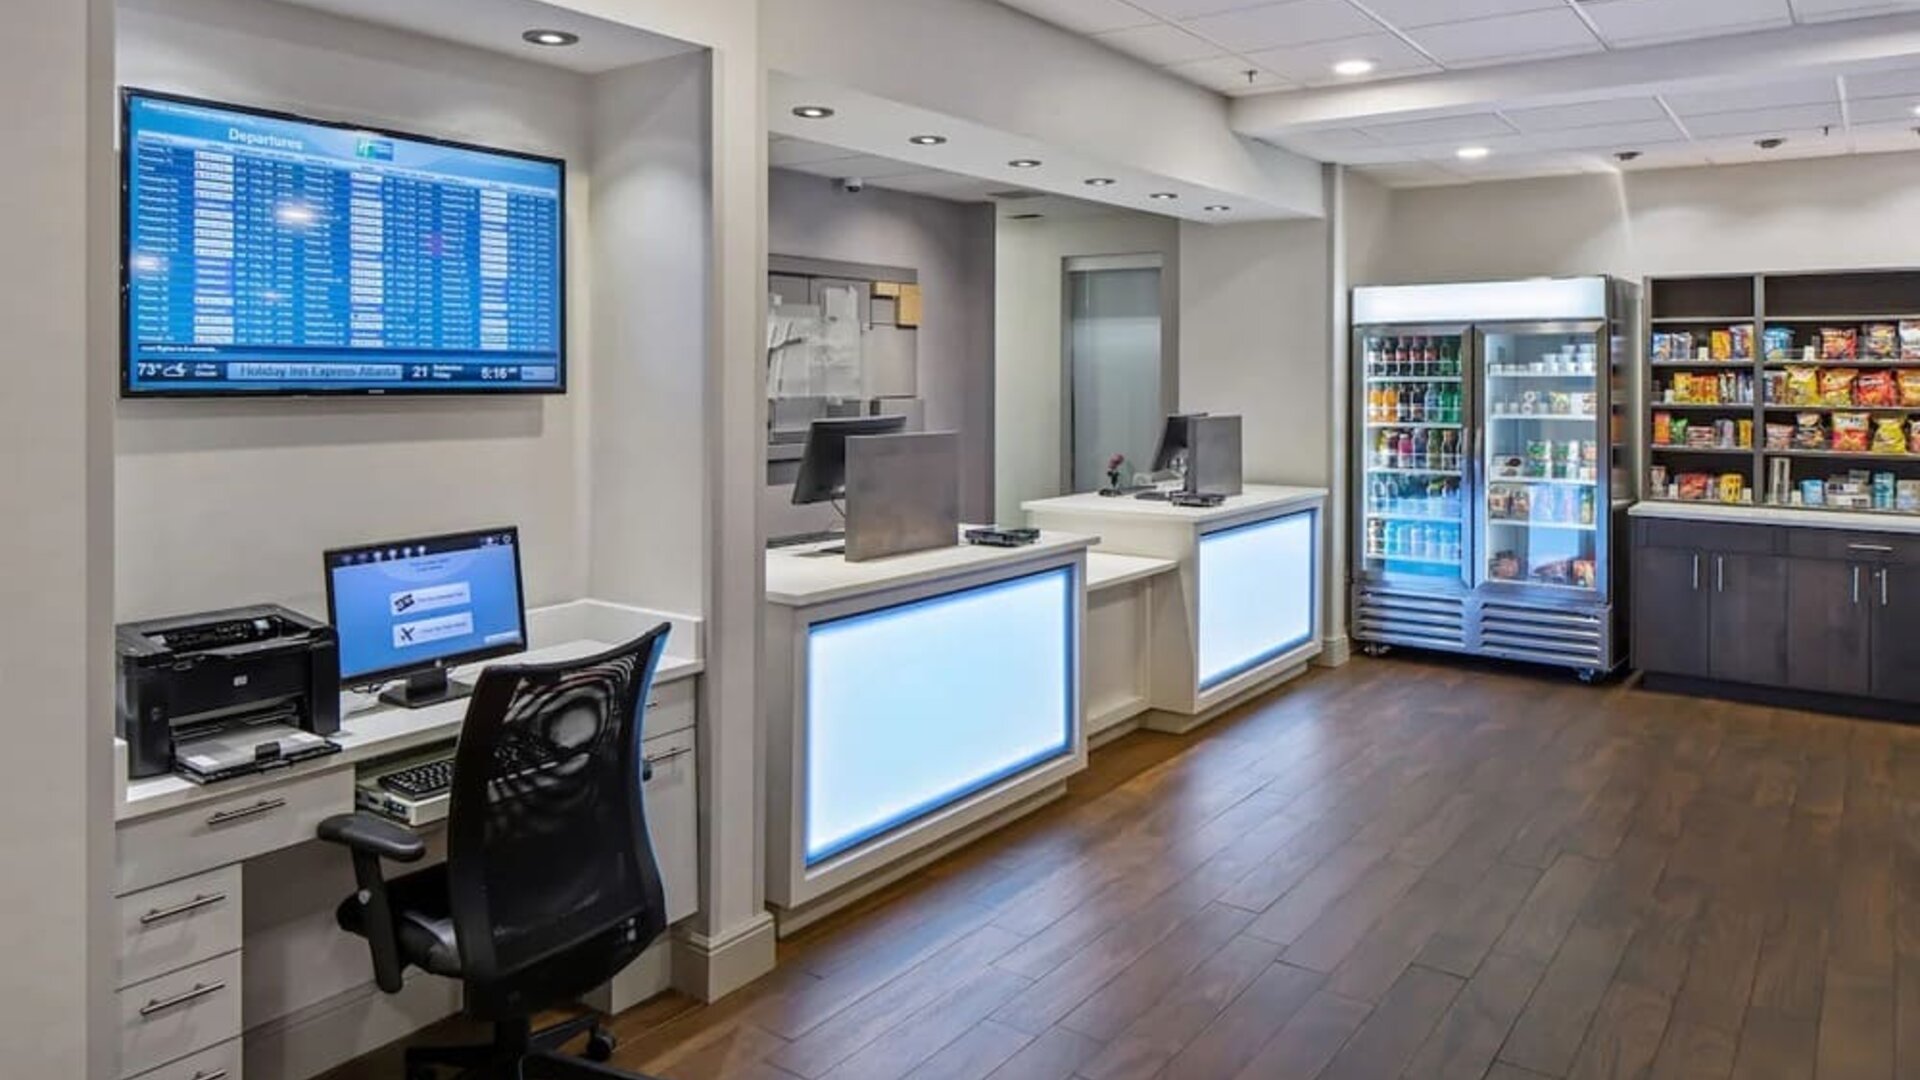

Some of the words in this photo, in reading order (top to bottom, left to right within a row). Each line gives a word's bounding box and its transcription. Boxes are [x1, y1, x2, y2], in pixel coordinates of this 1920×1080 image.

[228, 127, 304, 151] Departures
[240, 364, 285, 378] Holiday
[289, 365, 308, 377] Inn
[310, 365, 355, 379] Express
[411, 365, 428, 378] 21
